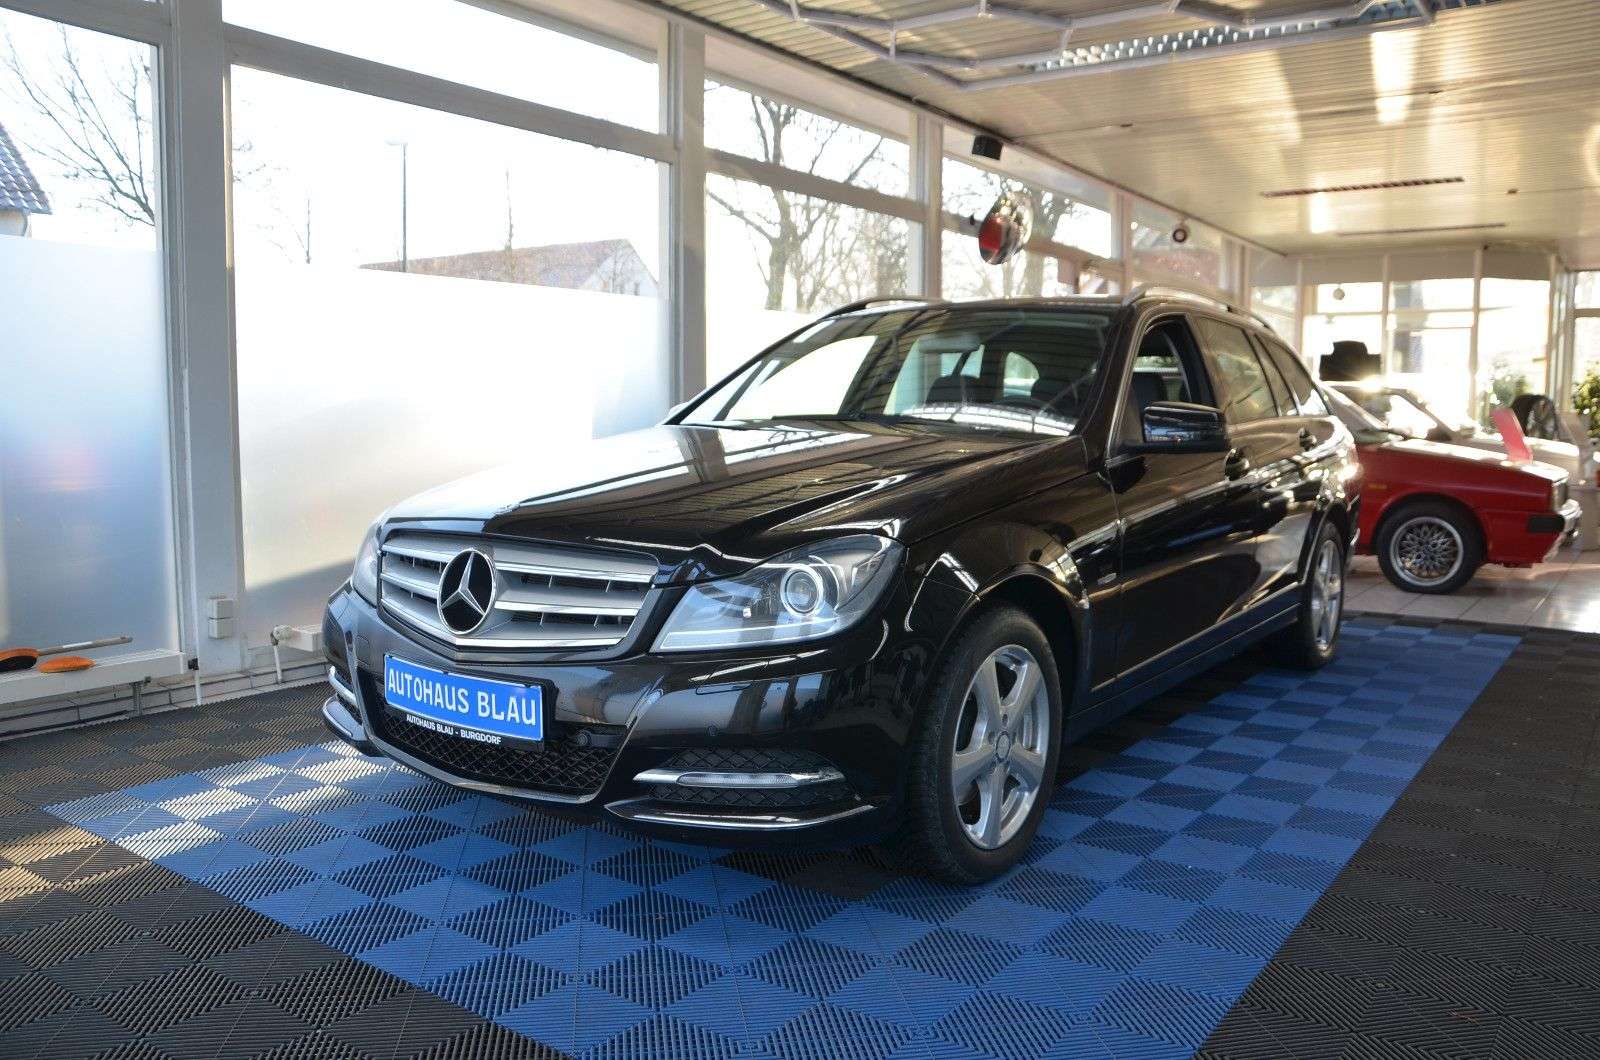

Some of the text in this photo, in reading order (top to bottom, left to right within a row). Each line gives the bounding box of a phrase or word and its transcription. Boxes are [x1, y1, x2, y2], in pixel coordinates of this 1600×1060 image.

[388, 668, 536, 726] AUTOHAUS BLAU
[406, 714, 436, 731] AUTOHAUS
[437, 723, 454, 736] BLAU
[460, 729, 502, 745] BURGDORF
